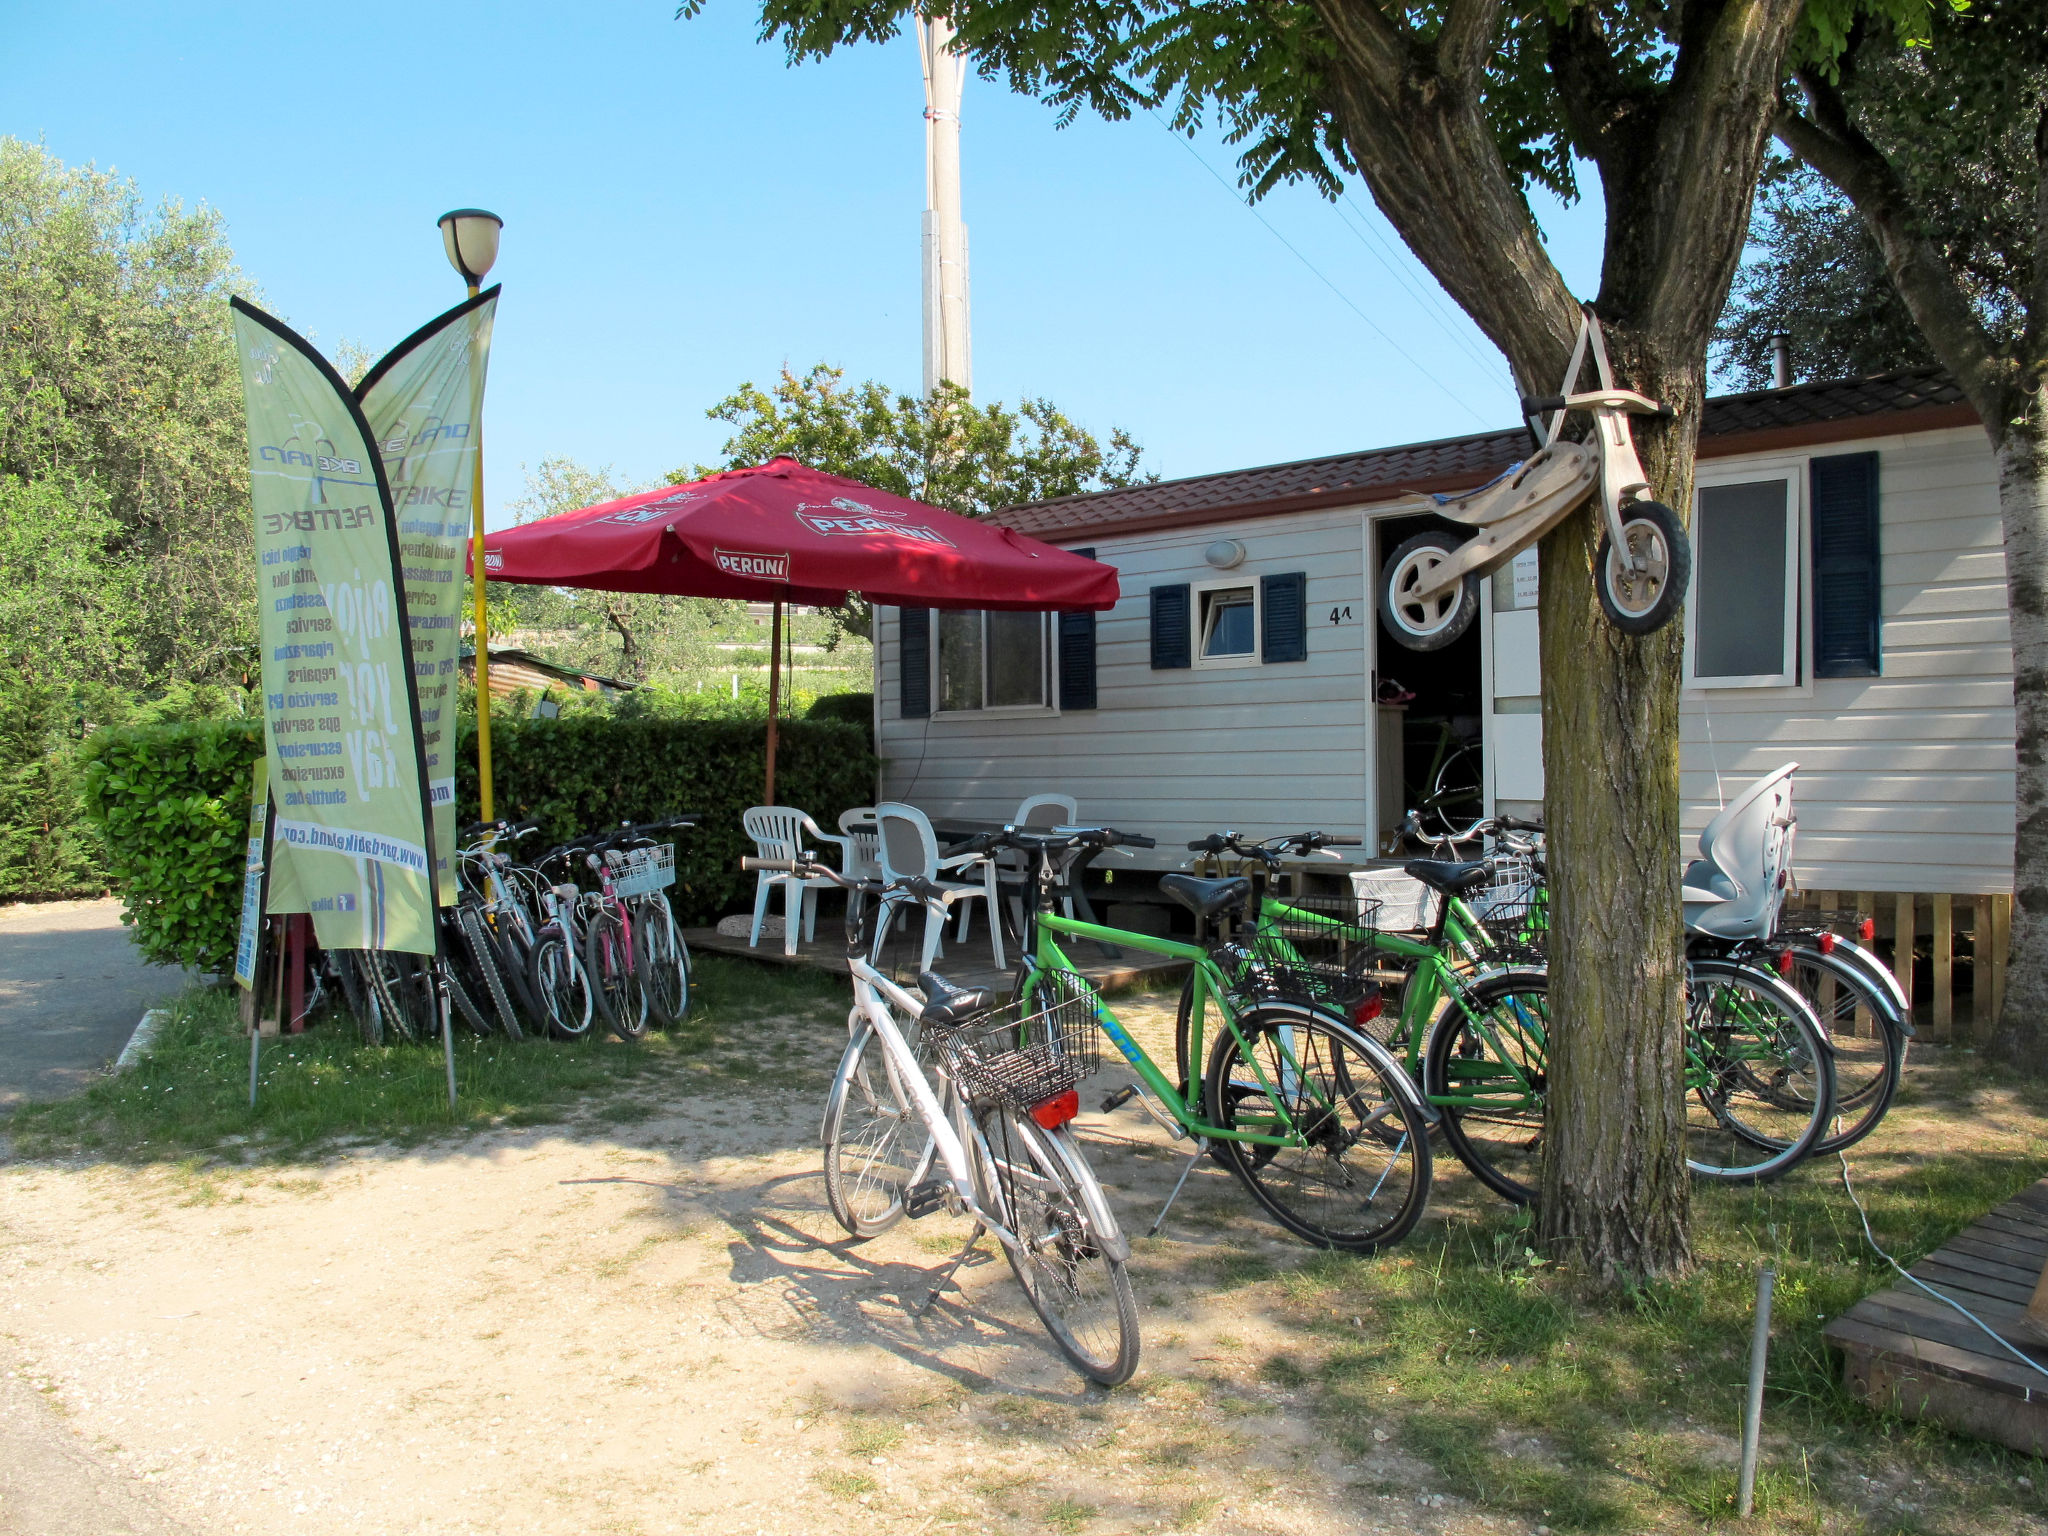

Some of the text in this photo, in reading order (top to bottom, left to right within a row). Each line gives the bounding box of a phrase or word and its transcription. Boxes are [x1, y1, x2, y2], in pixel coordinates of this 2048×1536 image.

[401, 543, 456, 560] rental bike
[719, 556, 784, 575] PERONI
[406, 590, 437, 606] ervice
